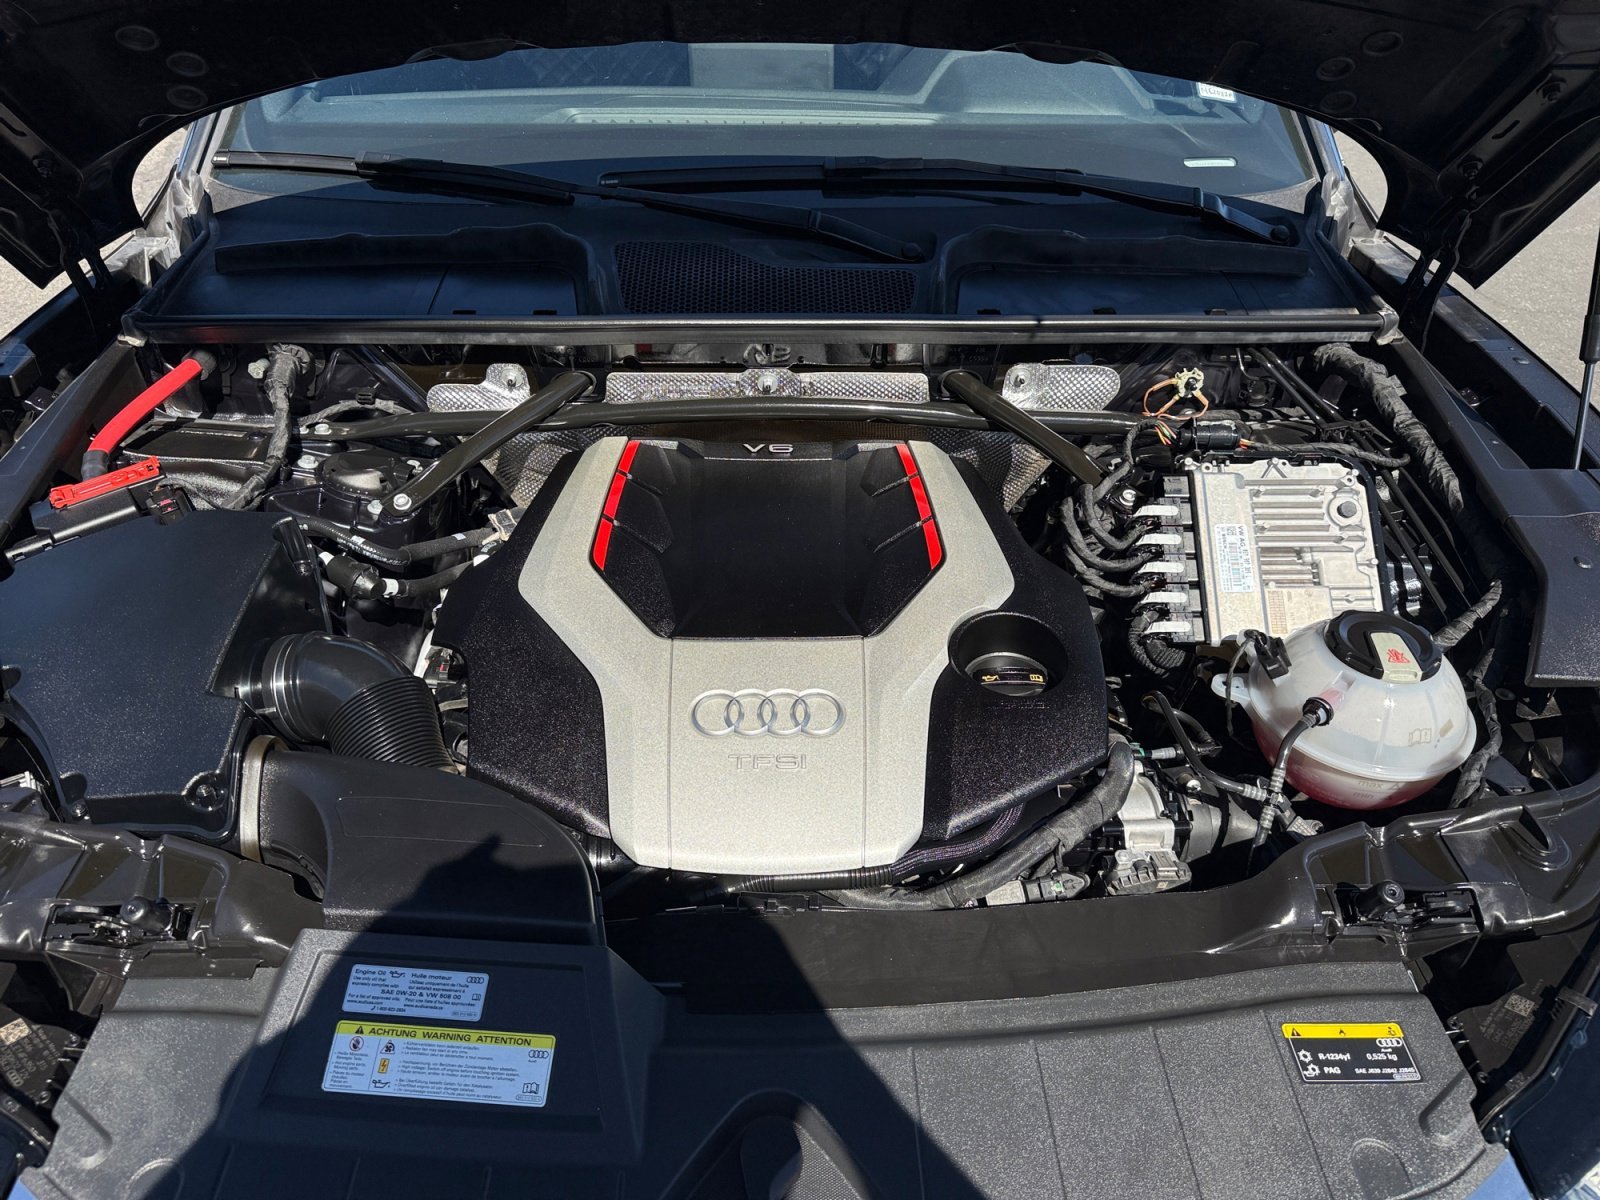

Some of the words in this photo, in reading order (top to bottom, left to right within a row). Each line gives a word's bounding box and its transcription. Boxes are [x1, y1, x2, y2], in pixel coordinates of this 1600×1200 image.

[743, 443, 794, 453] V6
[728, 754, 806, 769] TFSI
[369, 1027, 417, 1038] ACHTUNG
[422, 1031, 471, 1042] WARNING
[476, 1035, 532, 1046] ATTENTION
[1387, 1053, 1398, 1061] kg
[1323, 1066, 1341, 1074] PAG
